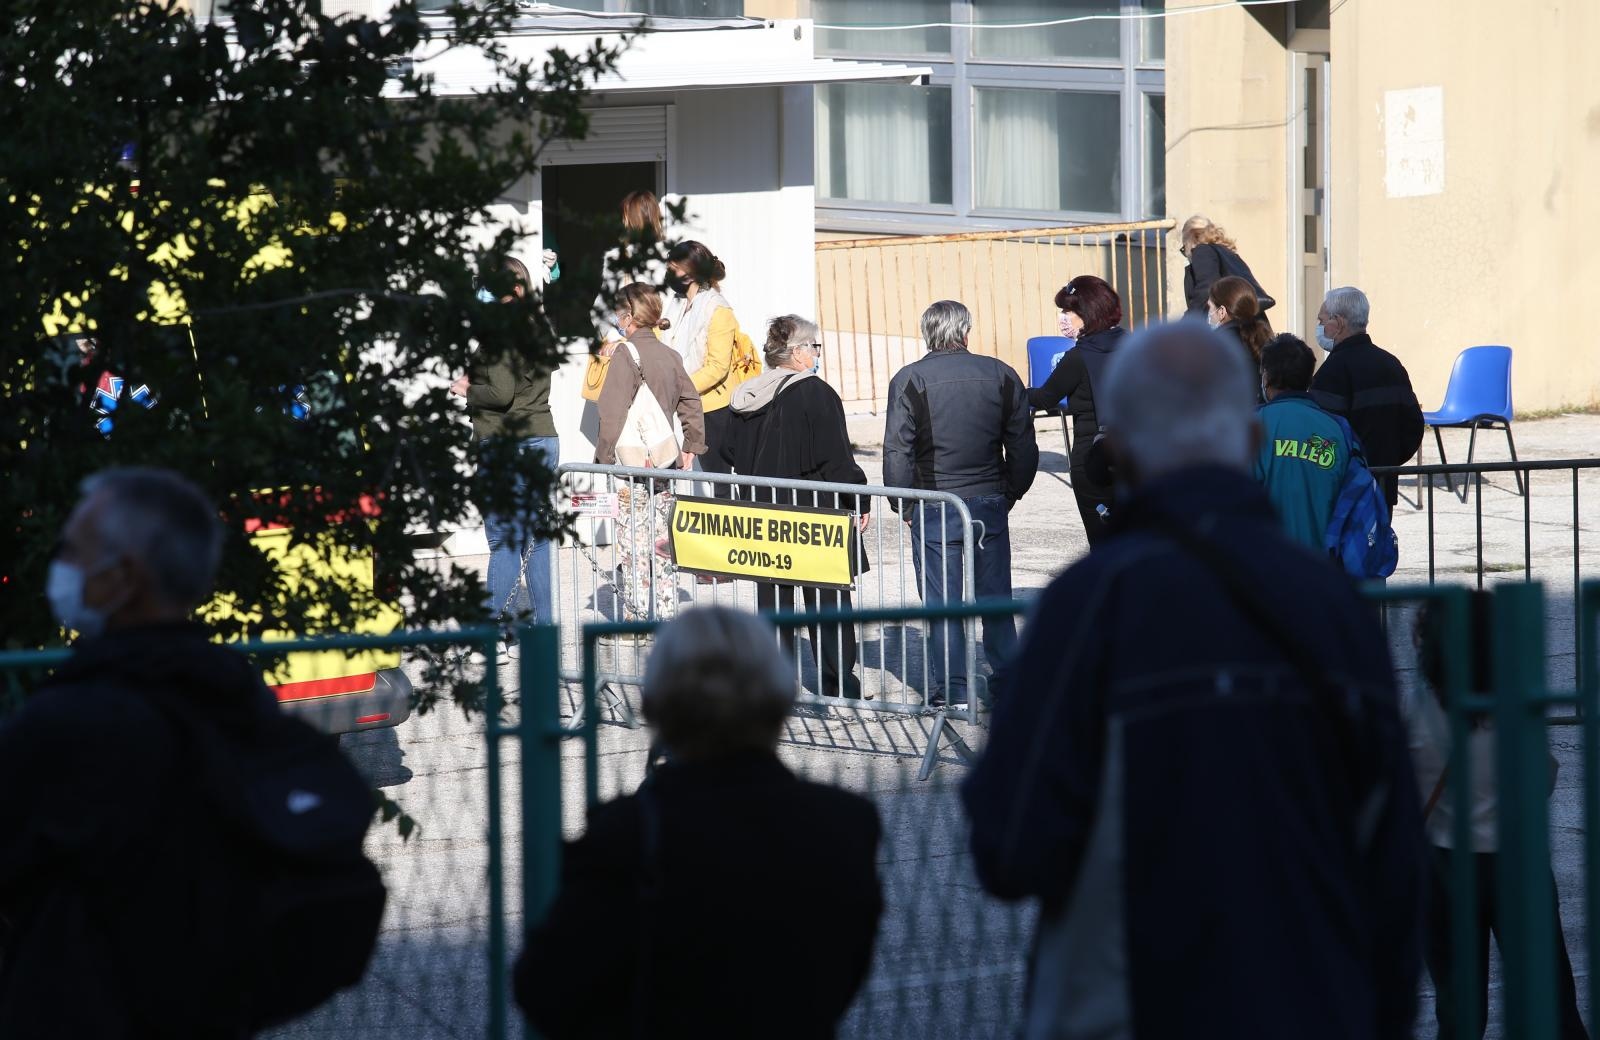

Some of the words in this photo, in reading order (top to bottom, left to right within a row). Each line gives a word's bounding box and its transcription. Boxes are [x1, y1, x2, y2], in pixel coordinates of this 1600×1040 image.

[676, 510, 763, 541] UZIMANJE
[768, 519, 844, 548] BRISEVA
[727, 549, 793, 570] COVID-19
